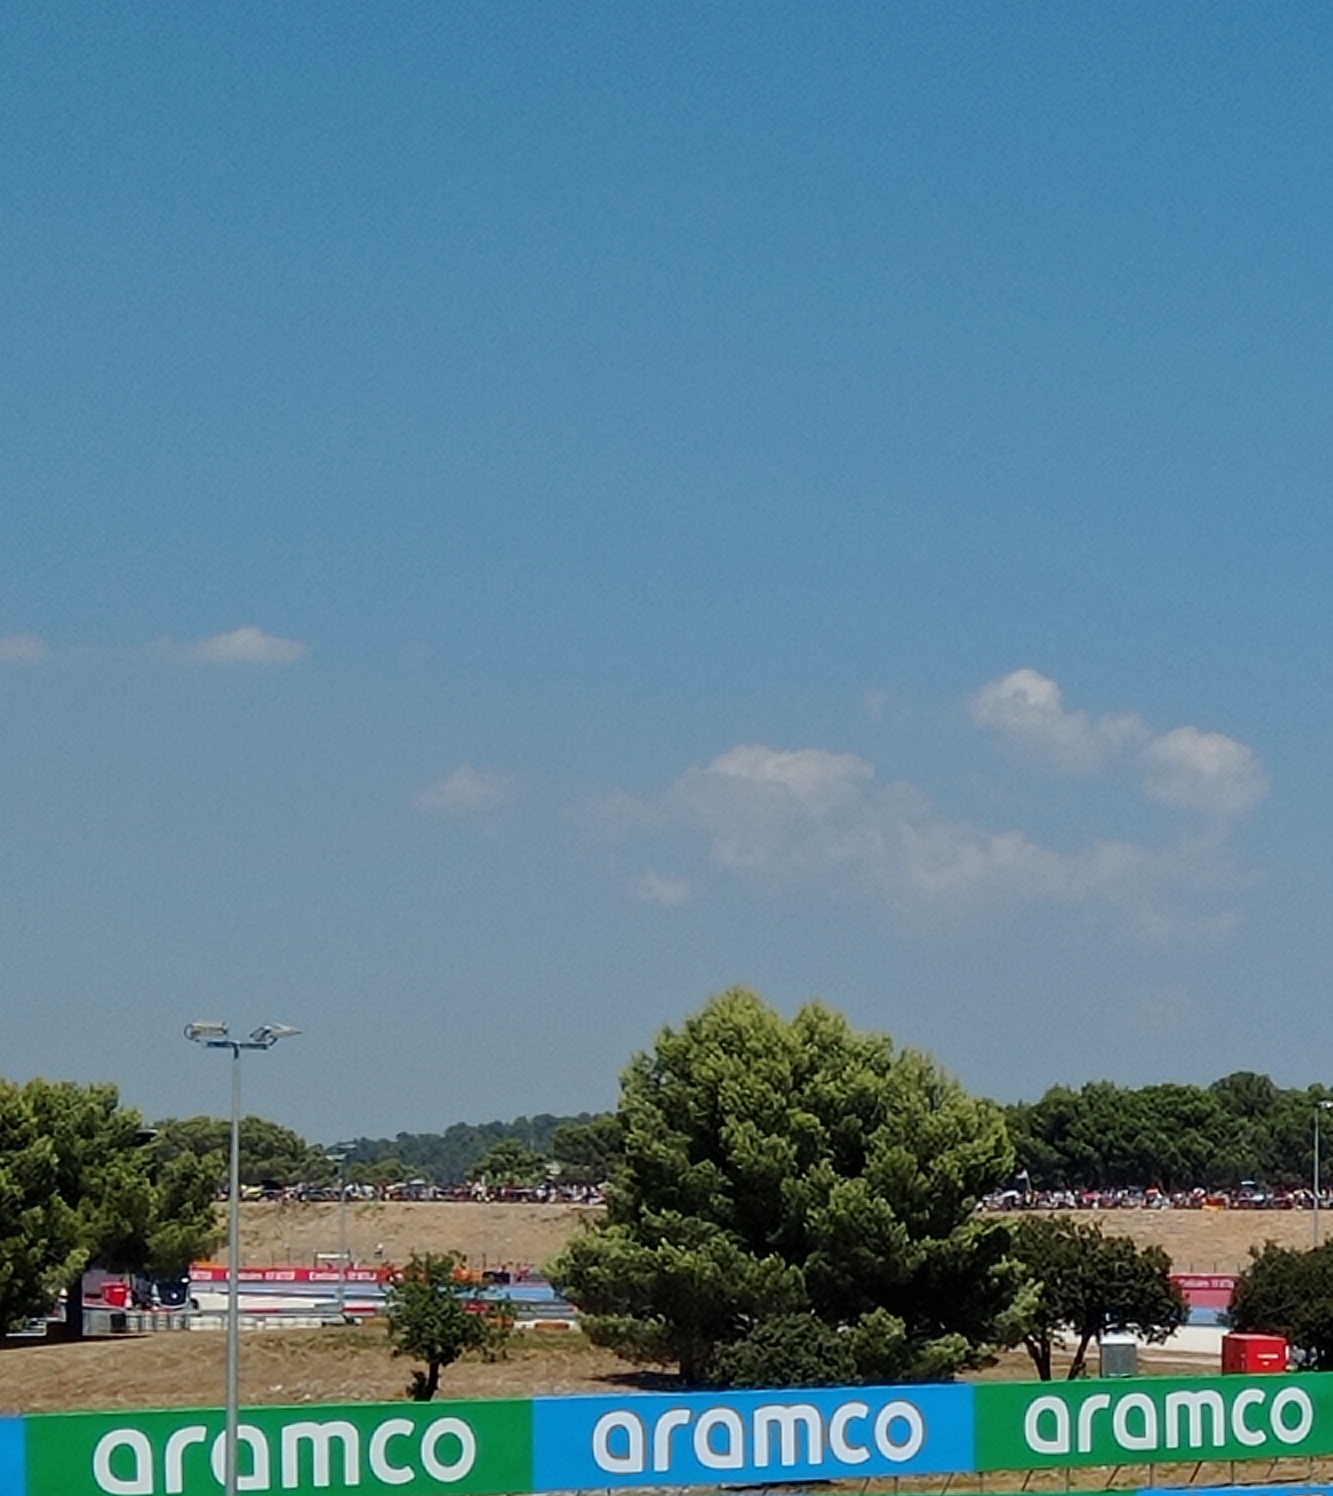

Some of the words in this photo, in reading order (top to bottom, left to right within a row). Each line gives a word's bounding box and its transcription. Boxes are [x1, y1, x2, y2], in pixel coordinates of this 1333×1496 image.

[93, 1417, 476, 1495] aramco
[593, 1401, 924, 1473] aramco
[1025, 1387, 1313, 1454] aramco
